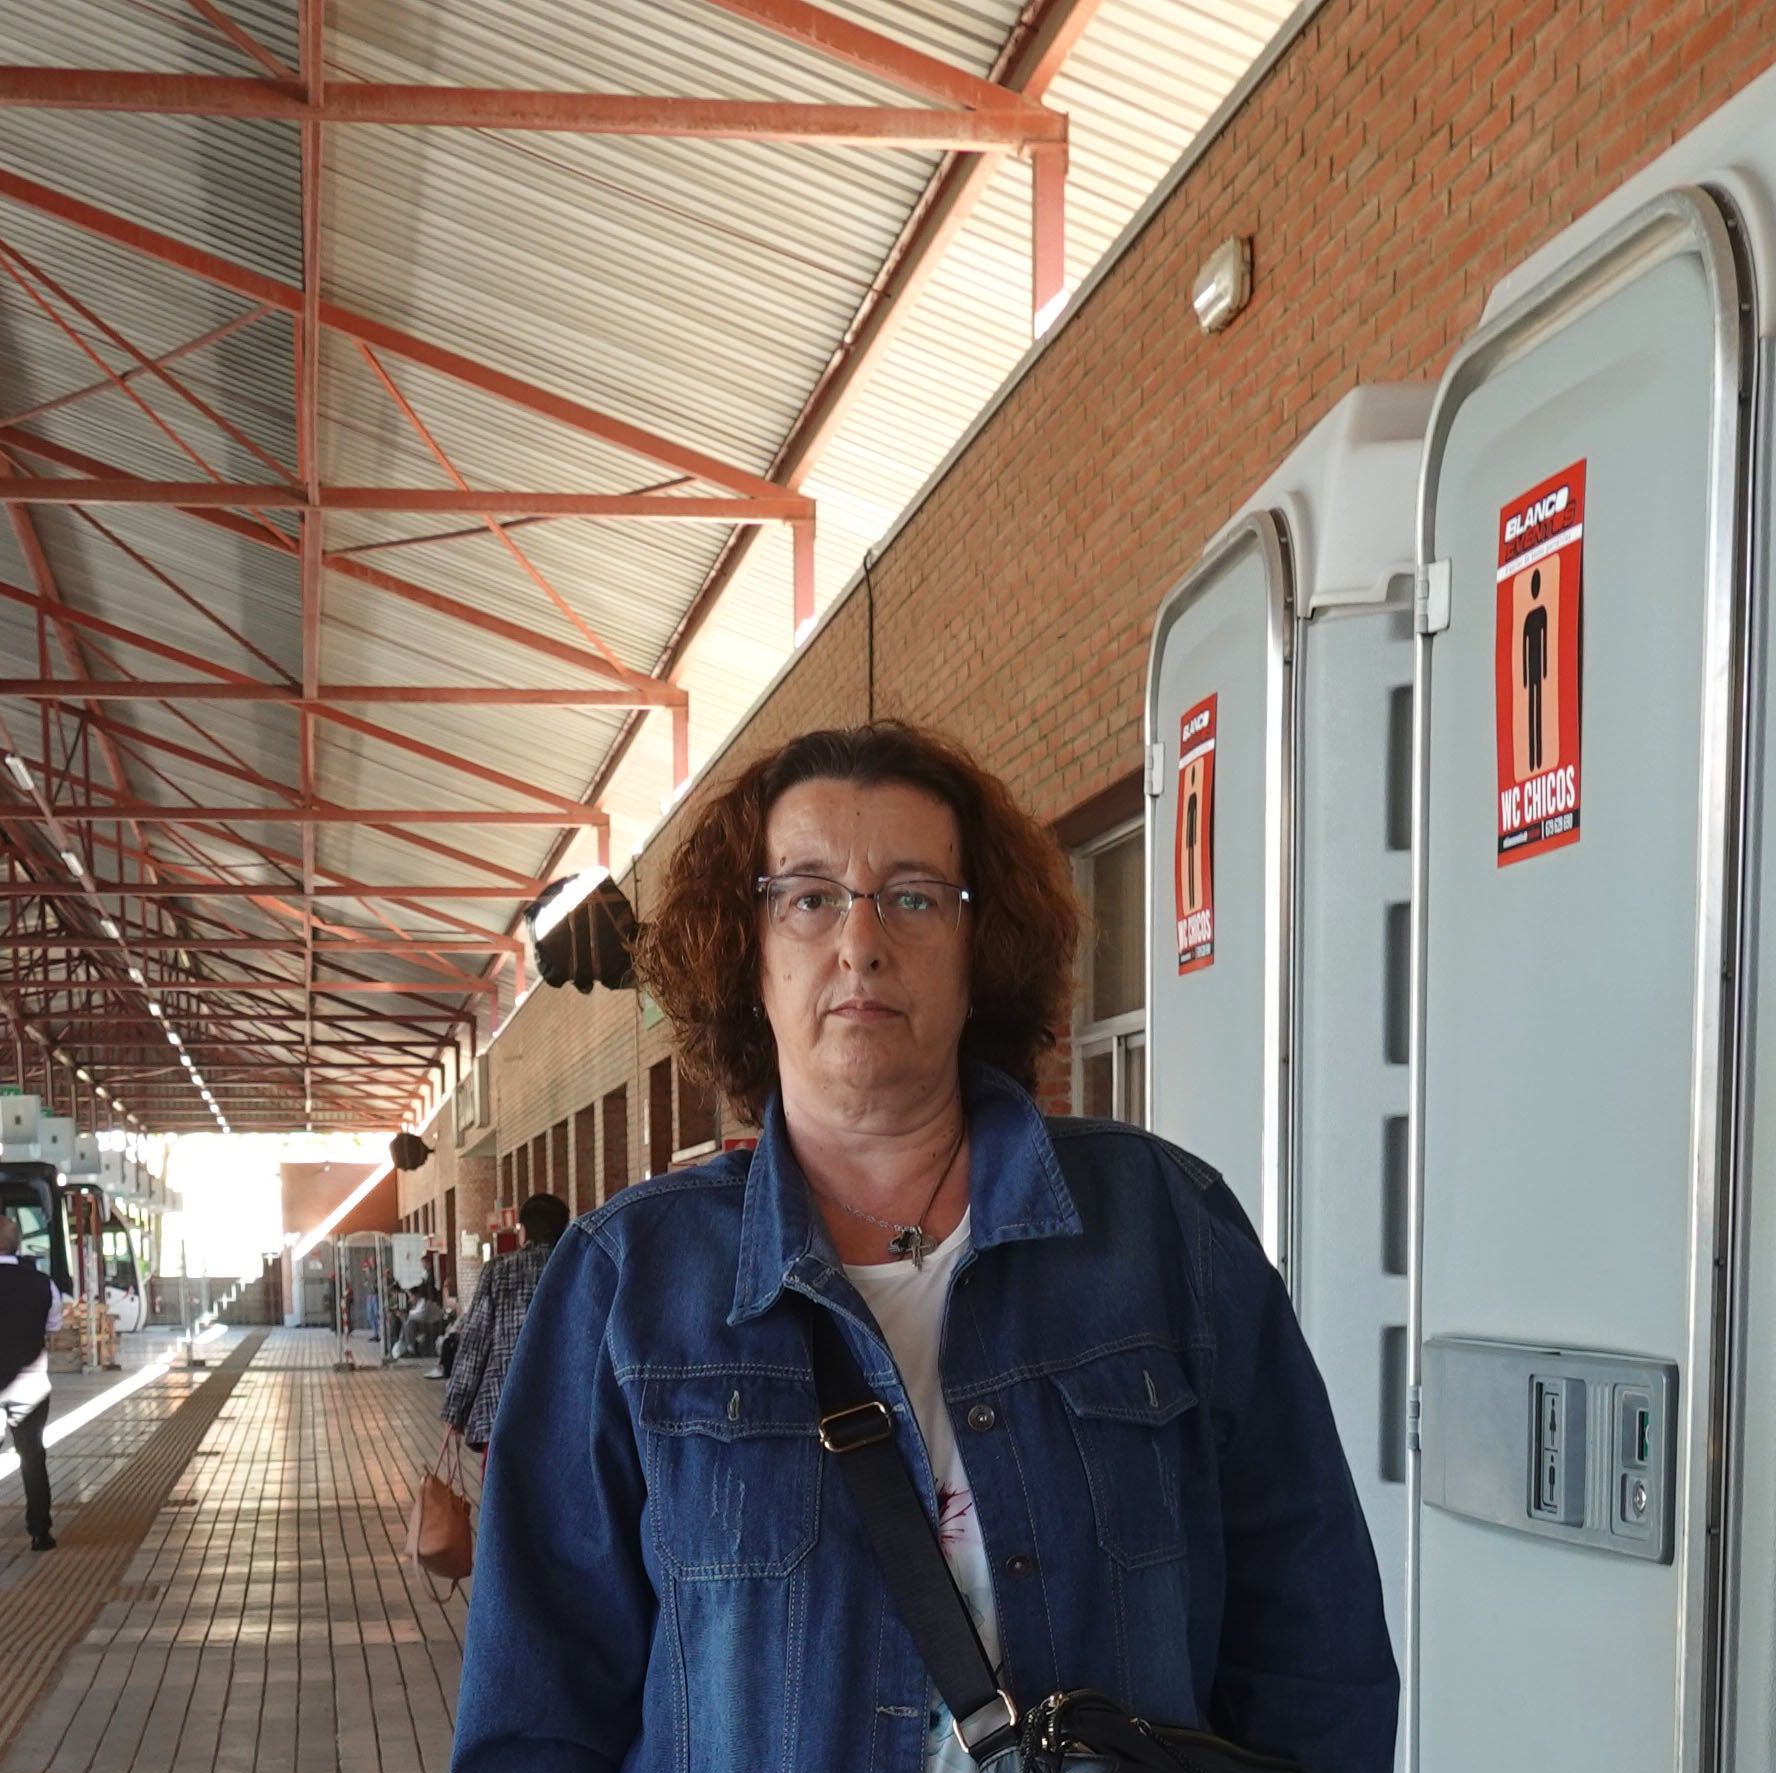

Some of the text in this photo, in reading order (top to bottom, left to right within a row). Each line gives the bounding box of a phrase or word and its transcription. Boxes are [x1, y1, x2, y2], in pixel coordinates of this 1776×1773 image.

[1504, 486, 1569, 543] BLANCO
[1501, 786, 1521, 832] WC
[1524, 765, 1575, 824] CHICOS
